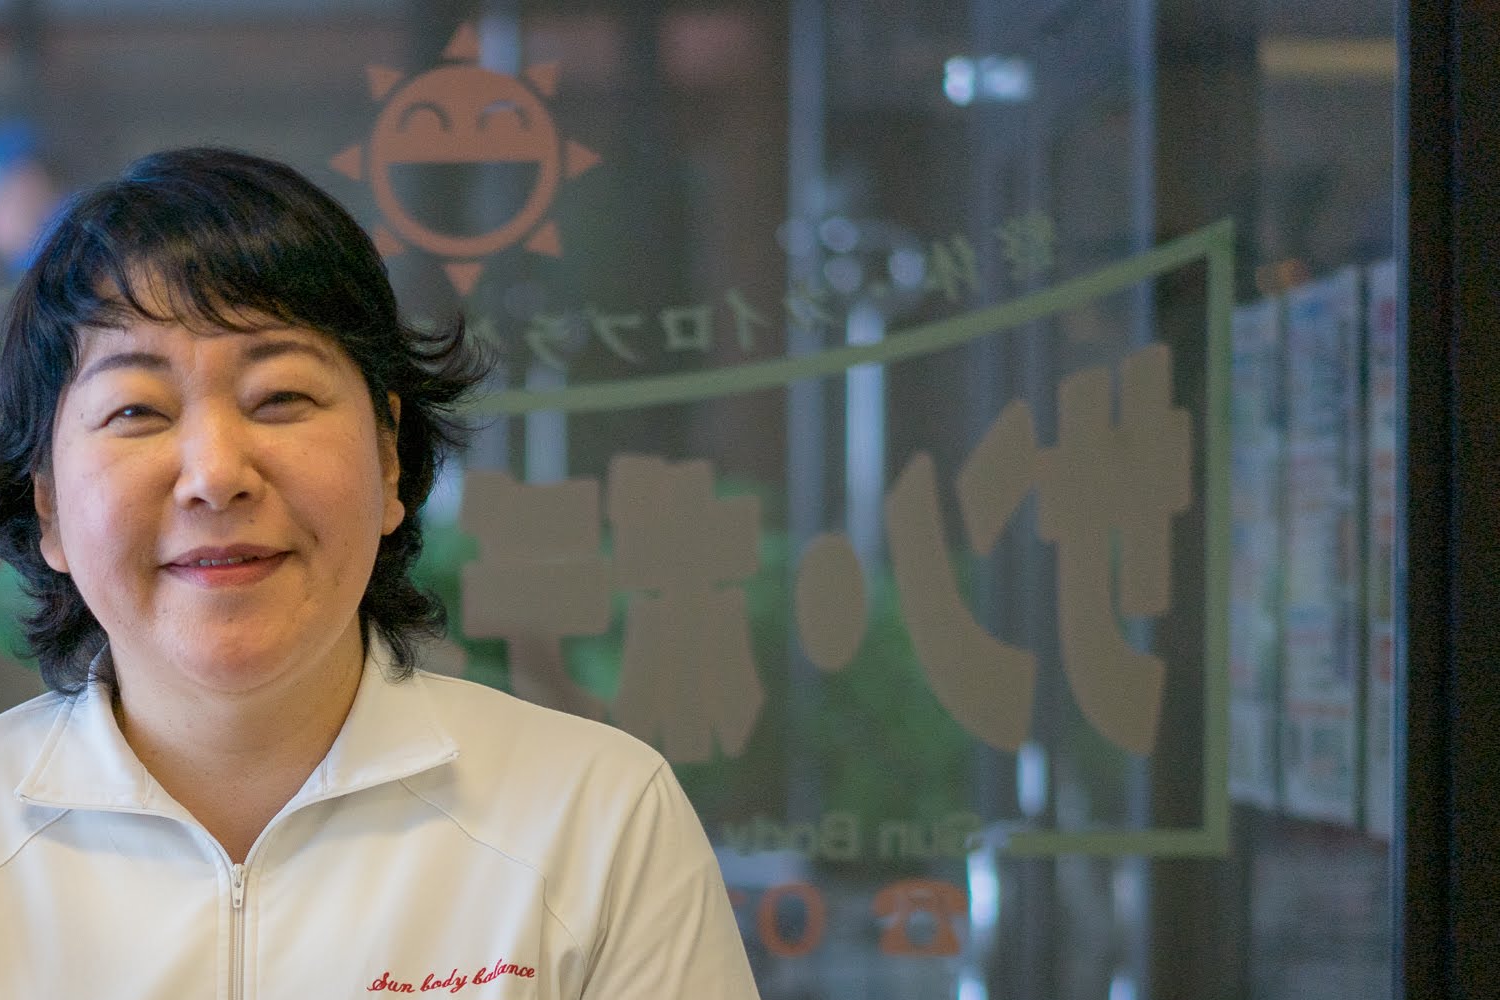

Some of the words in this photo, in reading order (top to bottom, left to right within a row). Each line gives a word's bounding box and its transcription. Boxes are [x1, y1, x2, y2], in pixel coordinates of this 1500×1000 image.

[367, 972, 415, 993] Sun
[420, 968, 467, 993] body
[472, 958, 535, 985] balance
